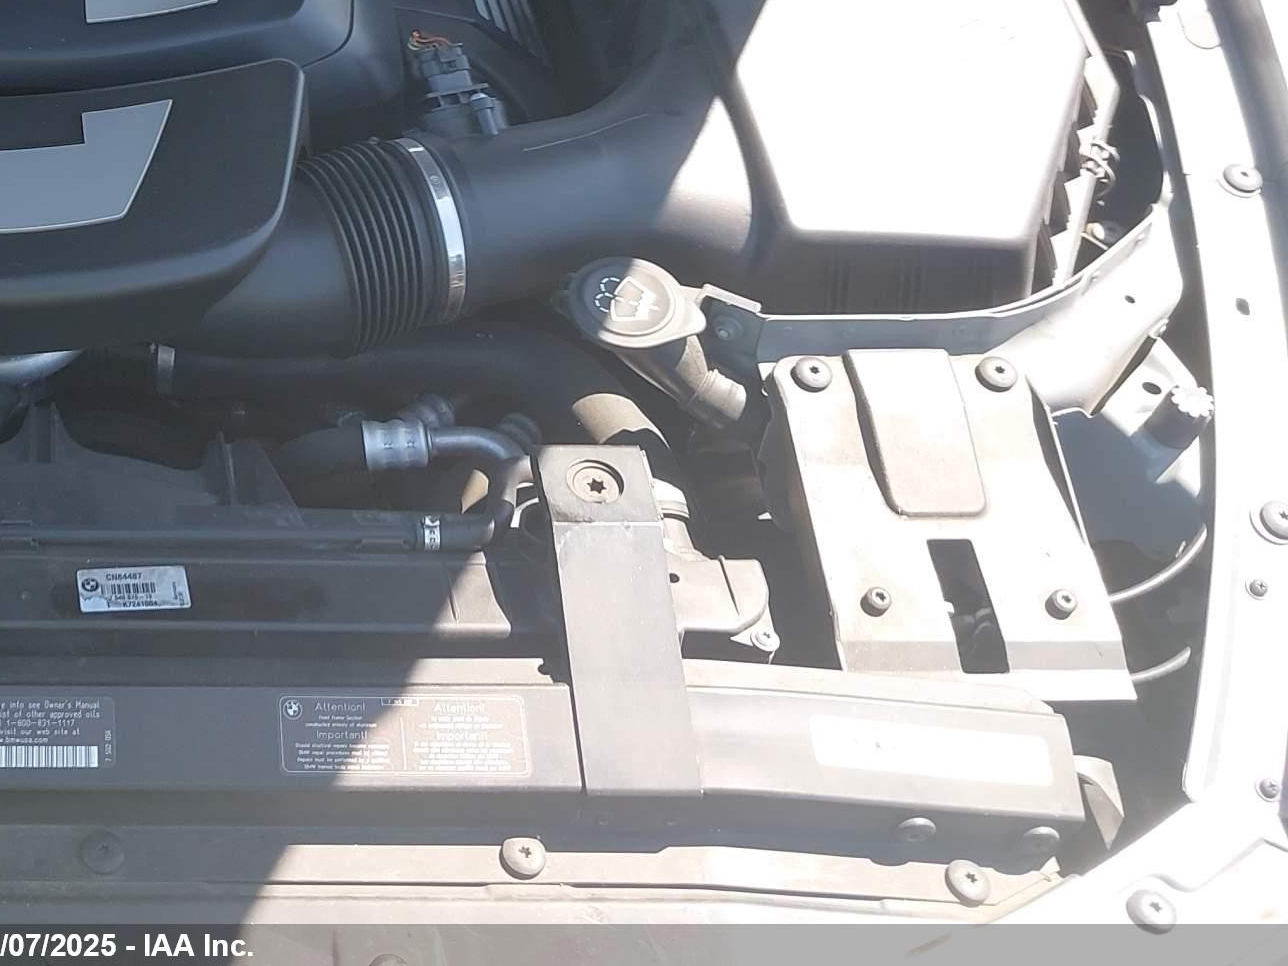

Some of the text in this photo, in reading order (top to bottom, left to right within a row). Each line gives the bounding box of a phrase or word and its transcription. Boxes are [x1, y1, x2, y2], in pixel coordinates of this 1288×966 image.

[10, 699, 25, 709] info
[75, 698, 100, 709] Manual
[49, 709, 82, 720] approved
